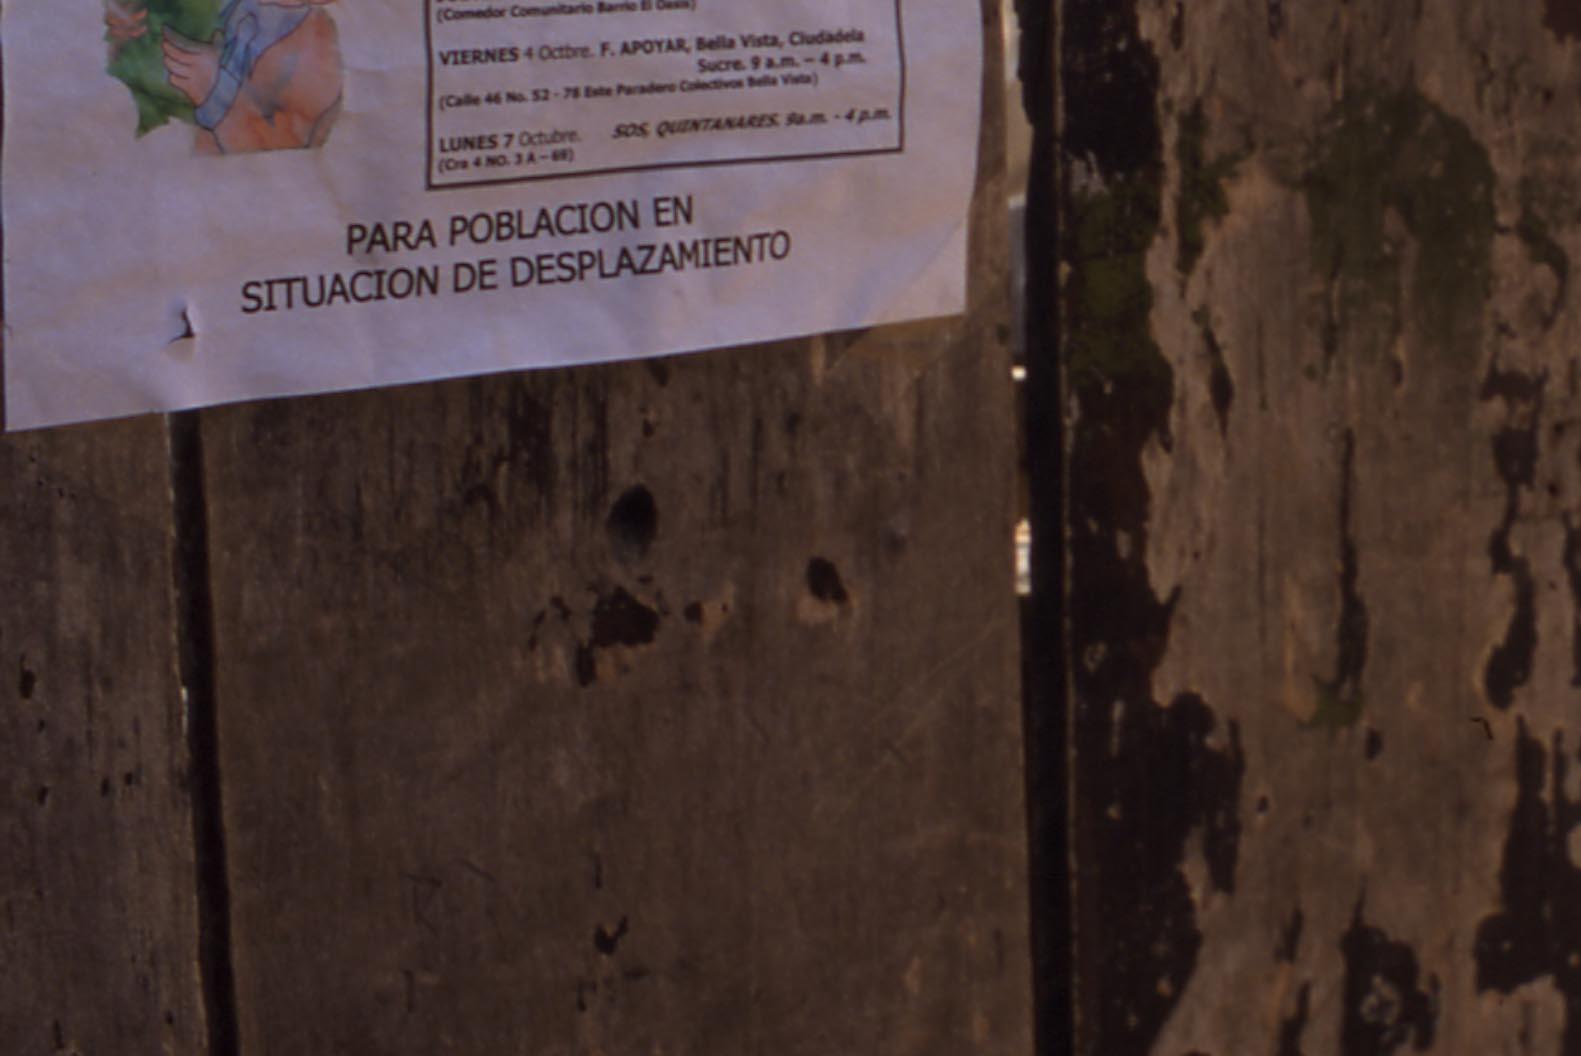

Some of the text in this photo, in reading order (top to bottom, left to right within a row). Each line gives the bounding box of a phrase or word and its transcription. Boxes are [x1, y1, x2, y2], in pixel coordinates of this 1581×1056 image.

[438, 46, 520, 66] VIERNES
[524, 46, 534, 60] 4
[600, 41, 615, 57] F.
[696, 34, 736, 50] Bella
[789, 28, 865, 45] Ciudadela
[751, 56, 761, 70] 9
[765, 56, 799, 68] a.m.
[819, 51, 830, 65] 4
[834, 51, 866, 68] p.m.
[439, 134, 499, 153] LUNES
[504, 133, 514, 148] 7
[346, 195, 694, 255] PARA POBLACION EN
[241, 230, 791, 314] SITUACION DE DESPLAZAMIENTO
